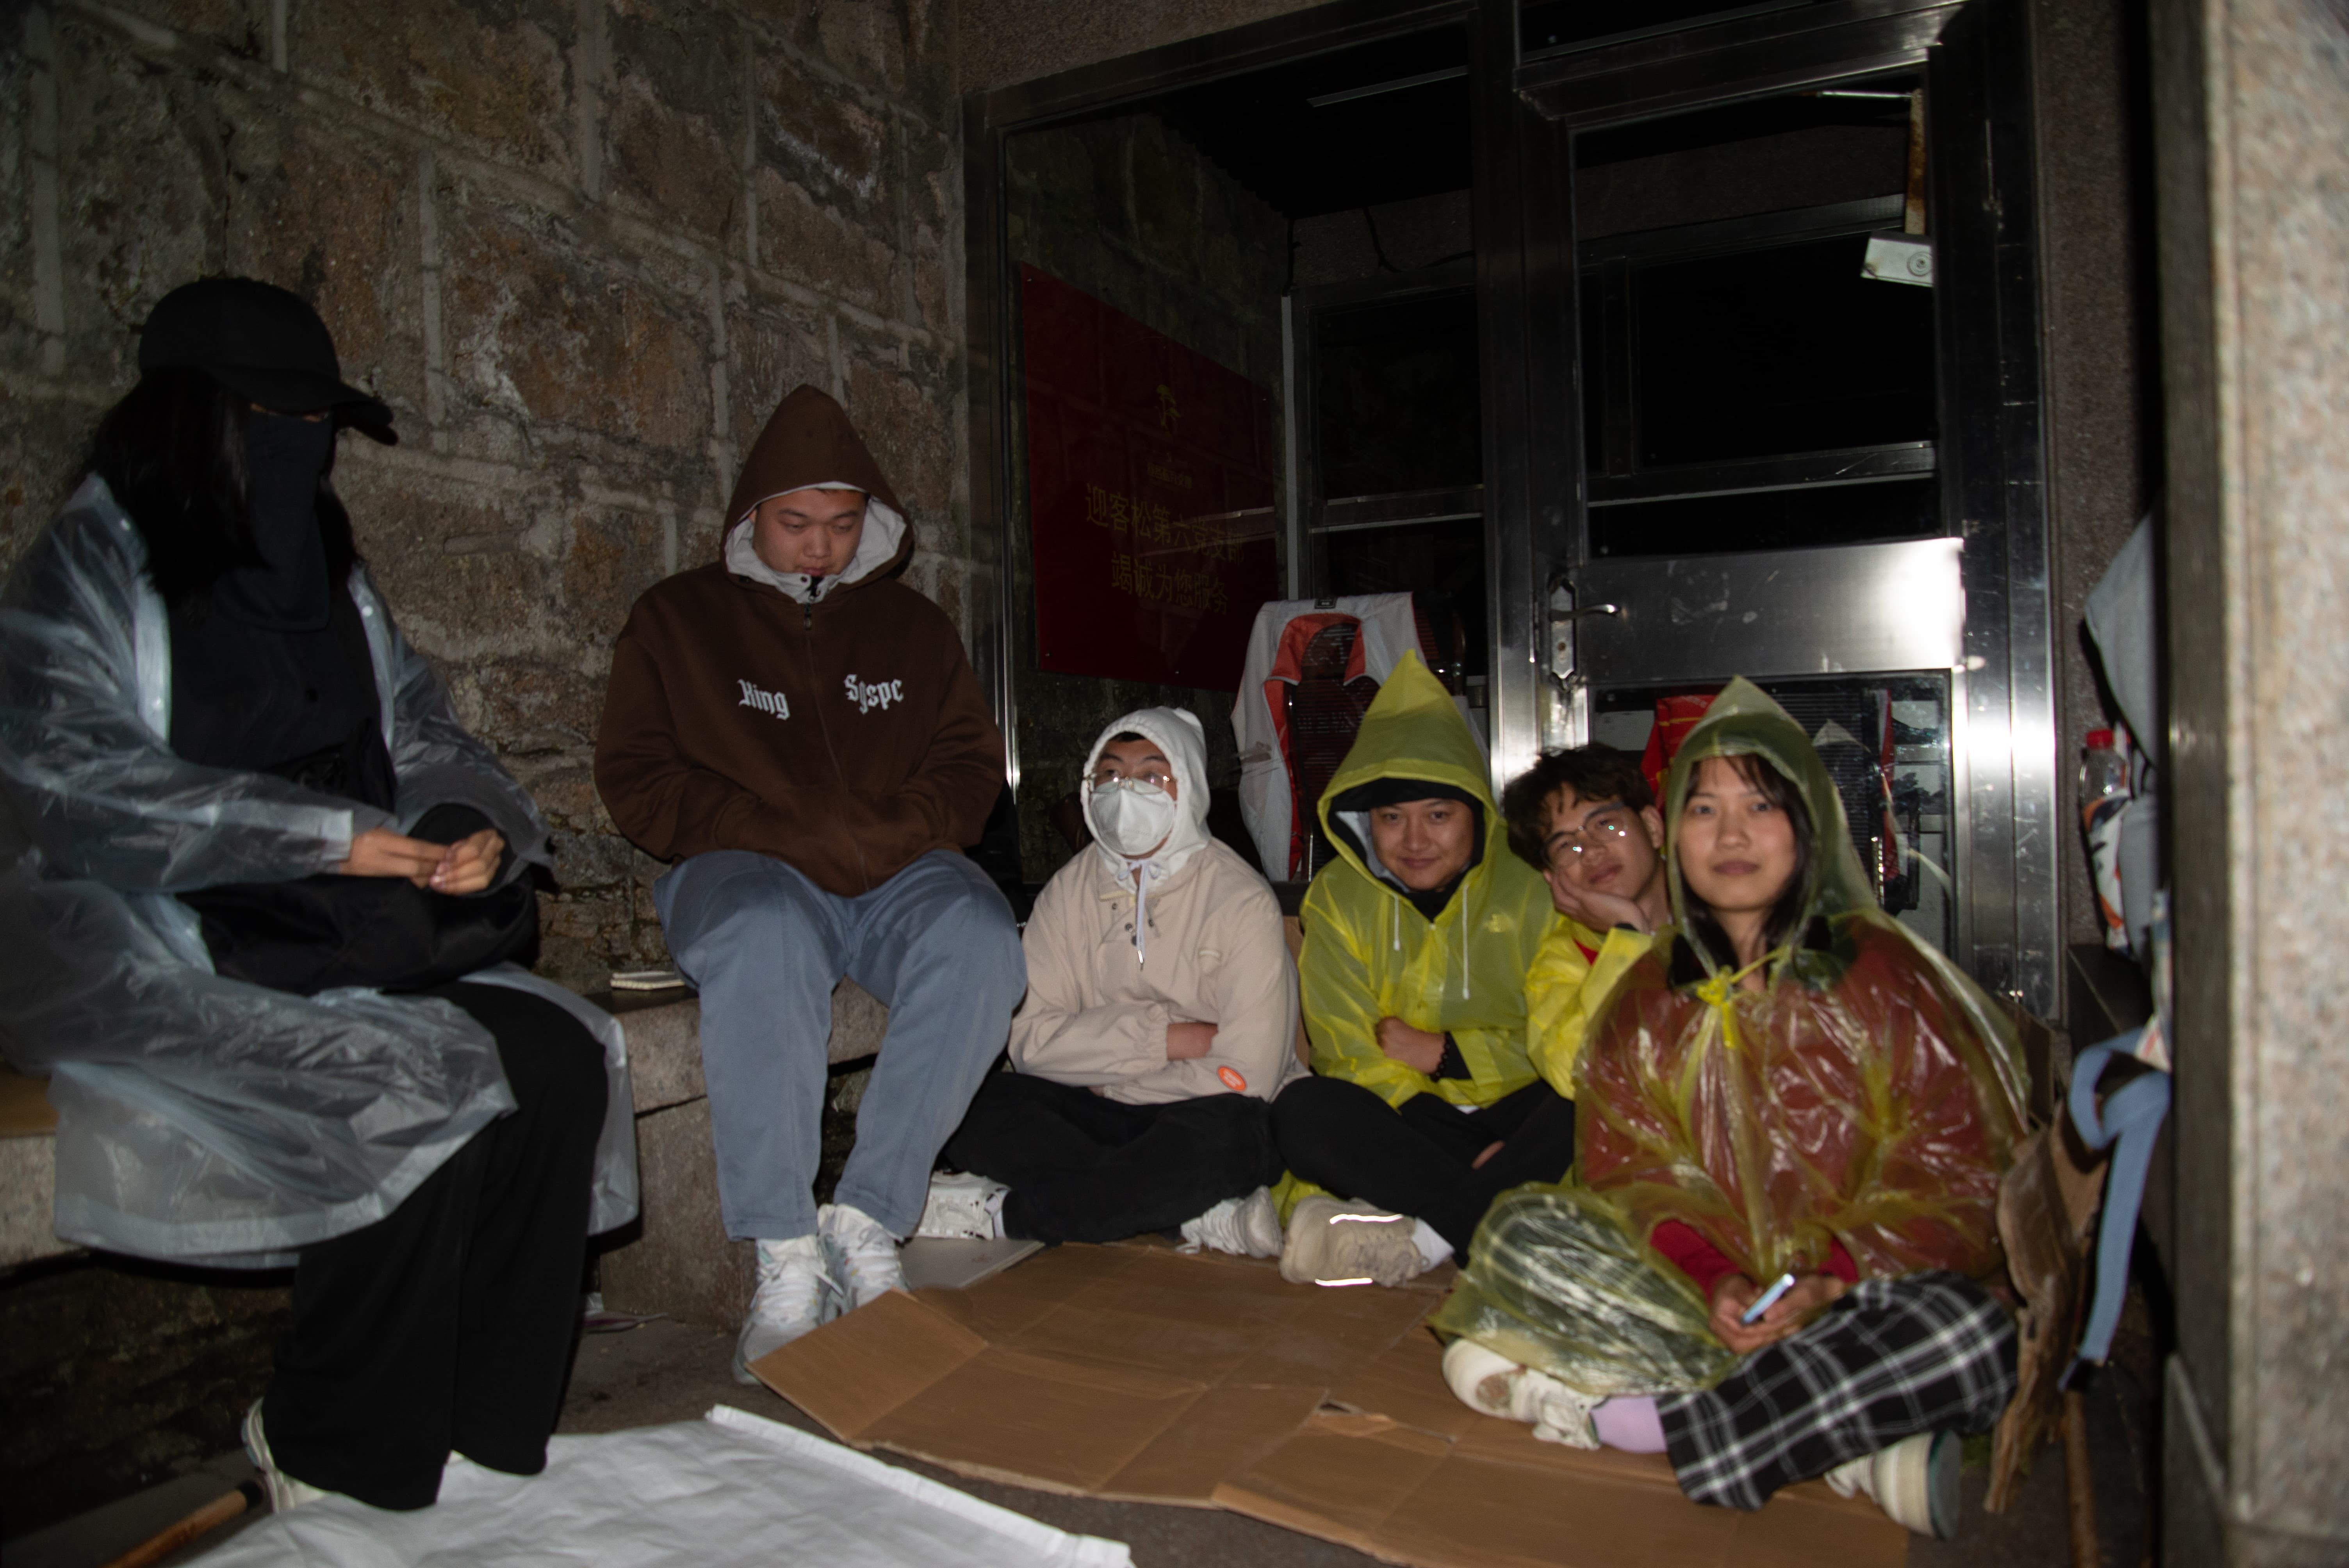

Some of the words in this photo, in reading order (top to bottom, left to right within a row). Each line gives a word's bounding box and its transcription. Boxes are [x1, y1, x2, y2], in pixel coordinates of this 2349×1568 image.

[1084, 483, 1244, 567] 迎客松第六党支部
[1111, 551, 1228, 615] 竭诚为您服务
